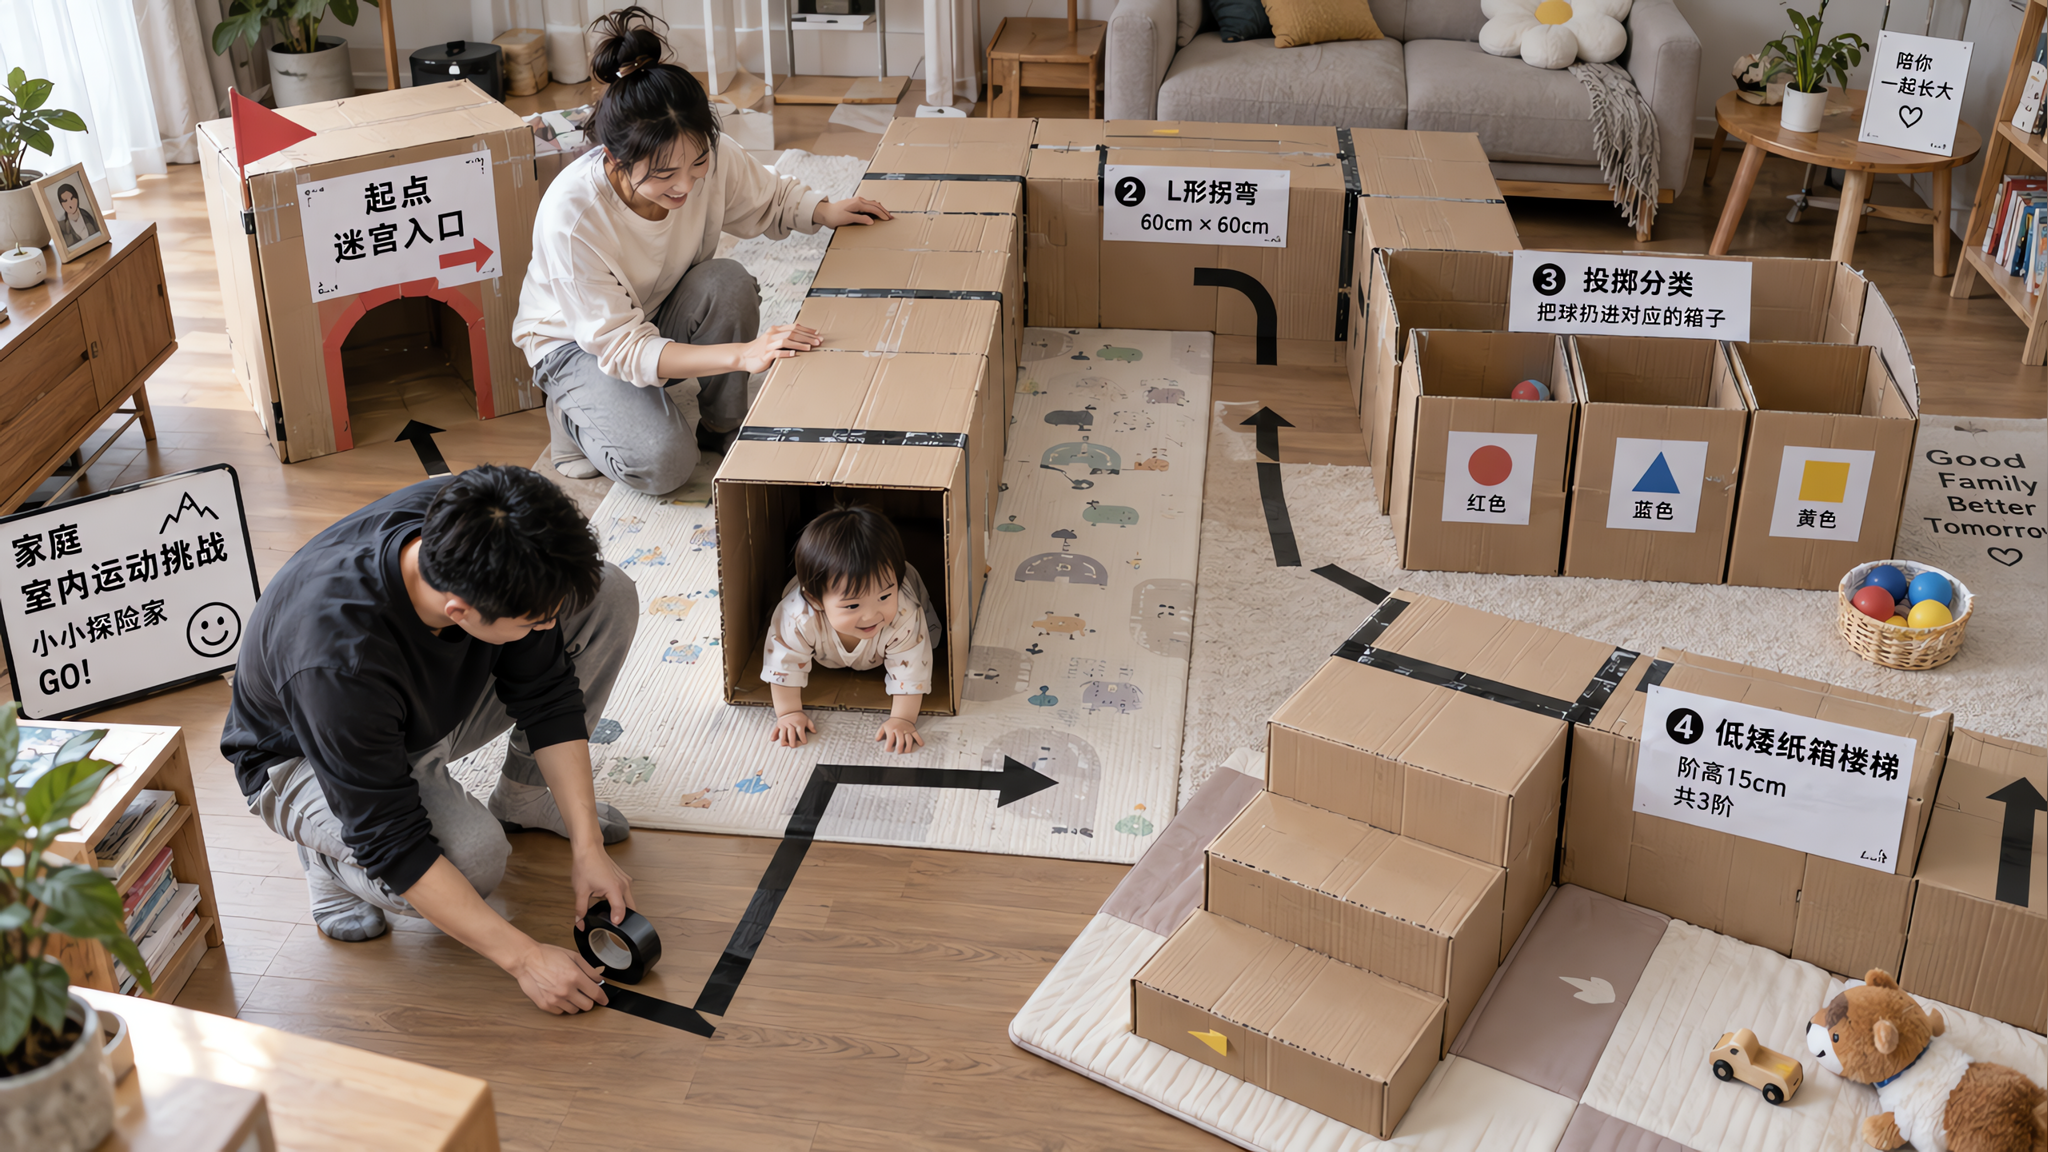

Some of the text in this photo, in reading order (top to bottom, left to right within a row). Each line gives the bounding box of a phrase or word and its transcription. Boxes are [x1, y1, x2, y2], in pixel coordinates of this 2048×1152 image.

[1896, 52, 1933, 72] 陪你
[1881, 76, 1954, 101] 一起长大
[364, 175, 432, 215] 起点
[1168, 179, 1258, 206] L形拐弯
[333, 210, 465, 264] 迷宫入口
[1141, 213, 1193, 232] 60cm
[1217, 216, 1269, 235] 60cm
[1583, 266, 1694, 298] 投掷分类
[1537, 302, 1726, 328] 把球扔进对应的箱子
[1926, 449, 2026, 469] Good
[1938, 471, 2038, 497] Family
[1466, 493, 1507, 514] 红色
[1632, 500, 1675, 521] 蓝色
[1946, 495, 2037, 516] Better
[1796, 508, 1837, 529] 黄色
[12, 523, 83, 569] 家庭
[21, 531, 229, 615] 室内运动挑战
[32, 599, 168, 657] 小小探险家
[39, 658, 92, 695] GO!
[1715, 718, 1900, 782] 低矮纸箱楼梯
[1677, 756, 1787, 798] 阶高15cm
[1673, 785, 1735, 818] 共3阶
